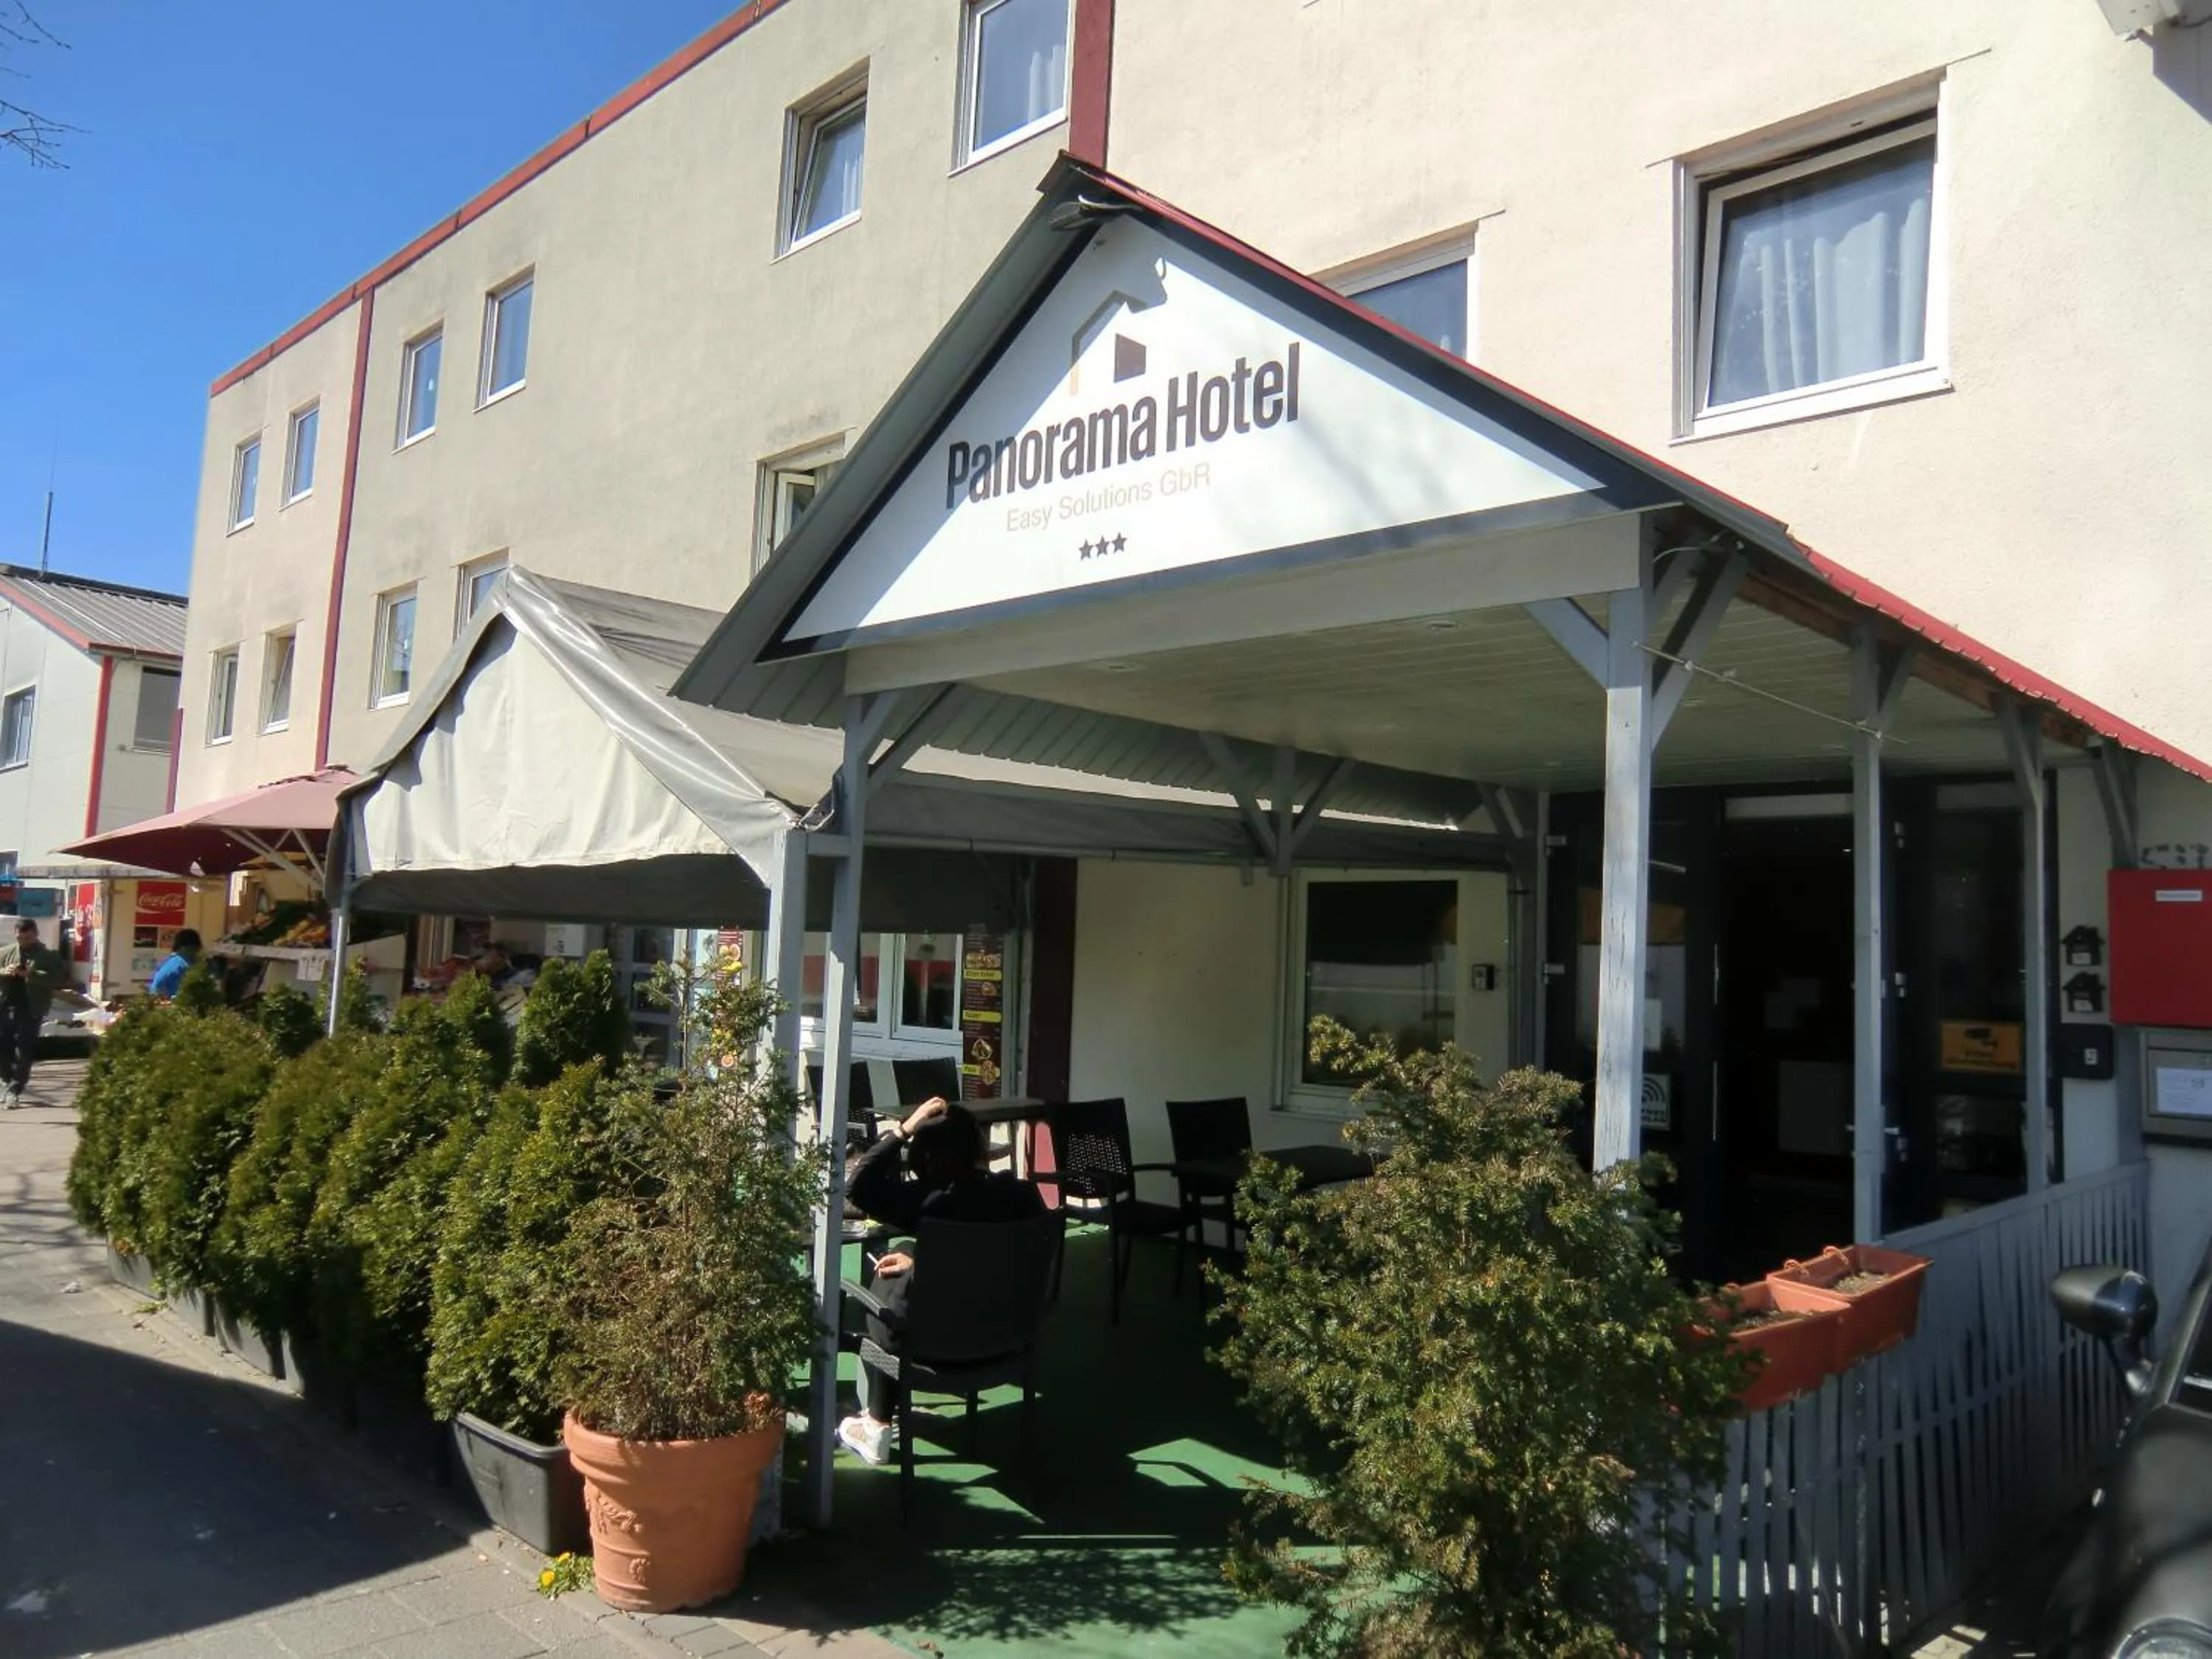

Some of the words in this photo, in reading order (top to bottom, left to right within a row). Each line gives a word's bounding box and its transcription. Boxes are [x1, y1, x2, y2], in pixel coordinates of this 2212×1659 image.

[945, 395, 1157, 509] Panorama
[1165, 341, 1300, 452] Hotel
[1006, 504, 1052, 532] Easy
[1058, 481, 1152, 521] Solutions
[1159, 462, 1211, 497] GbR
